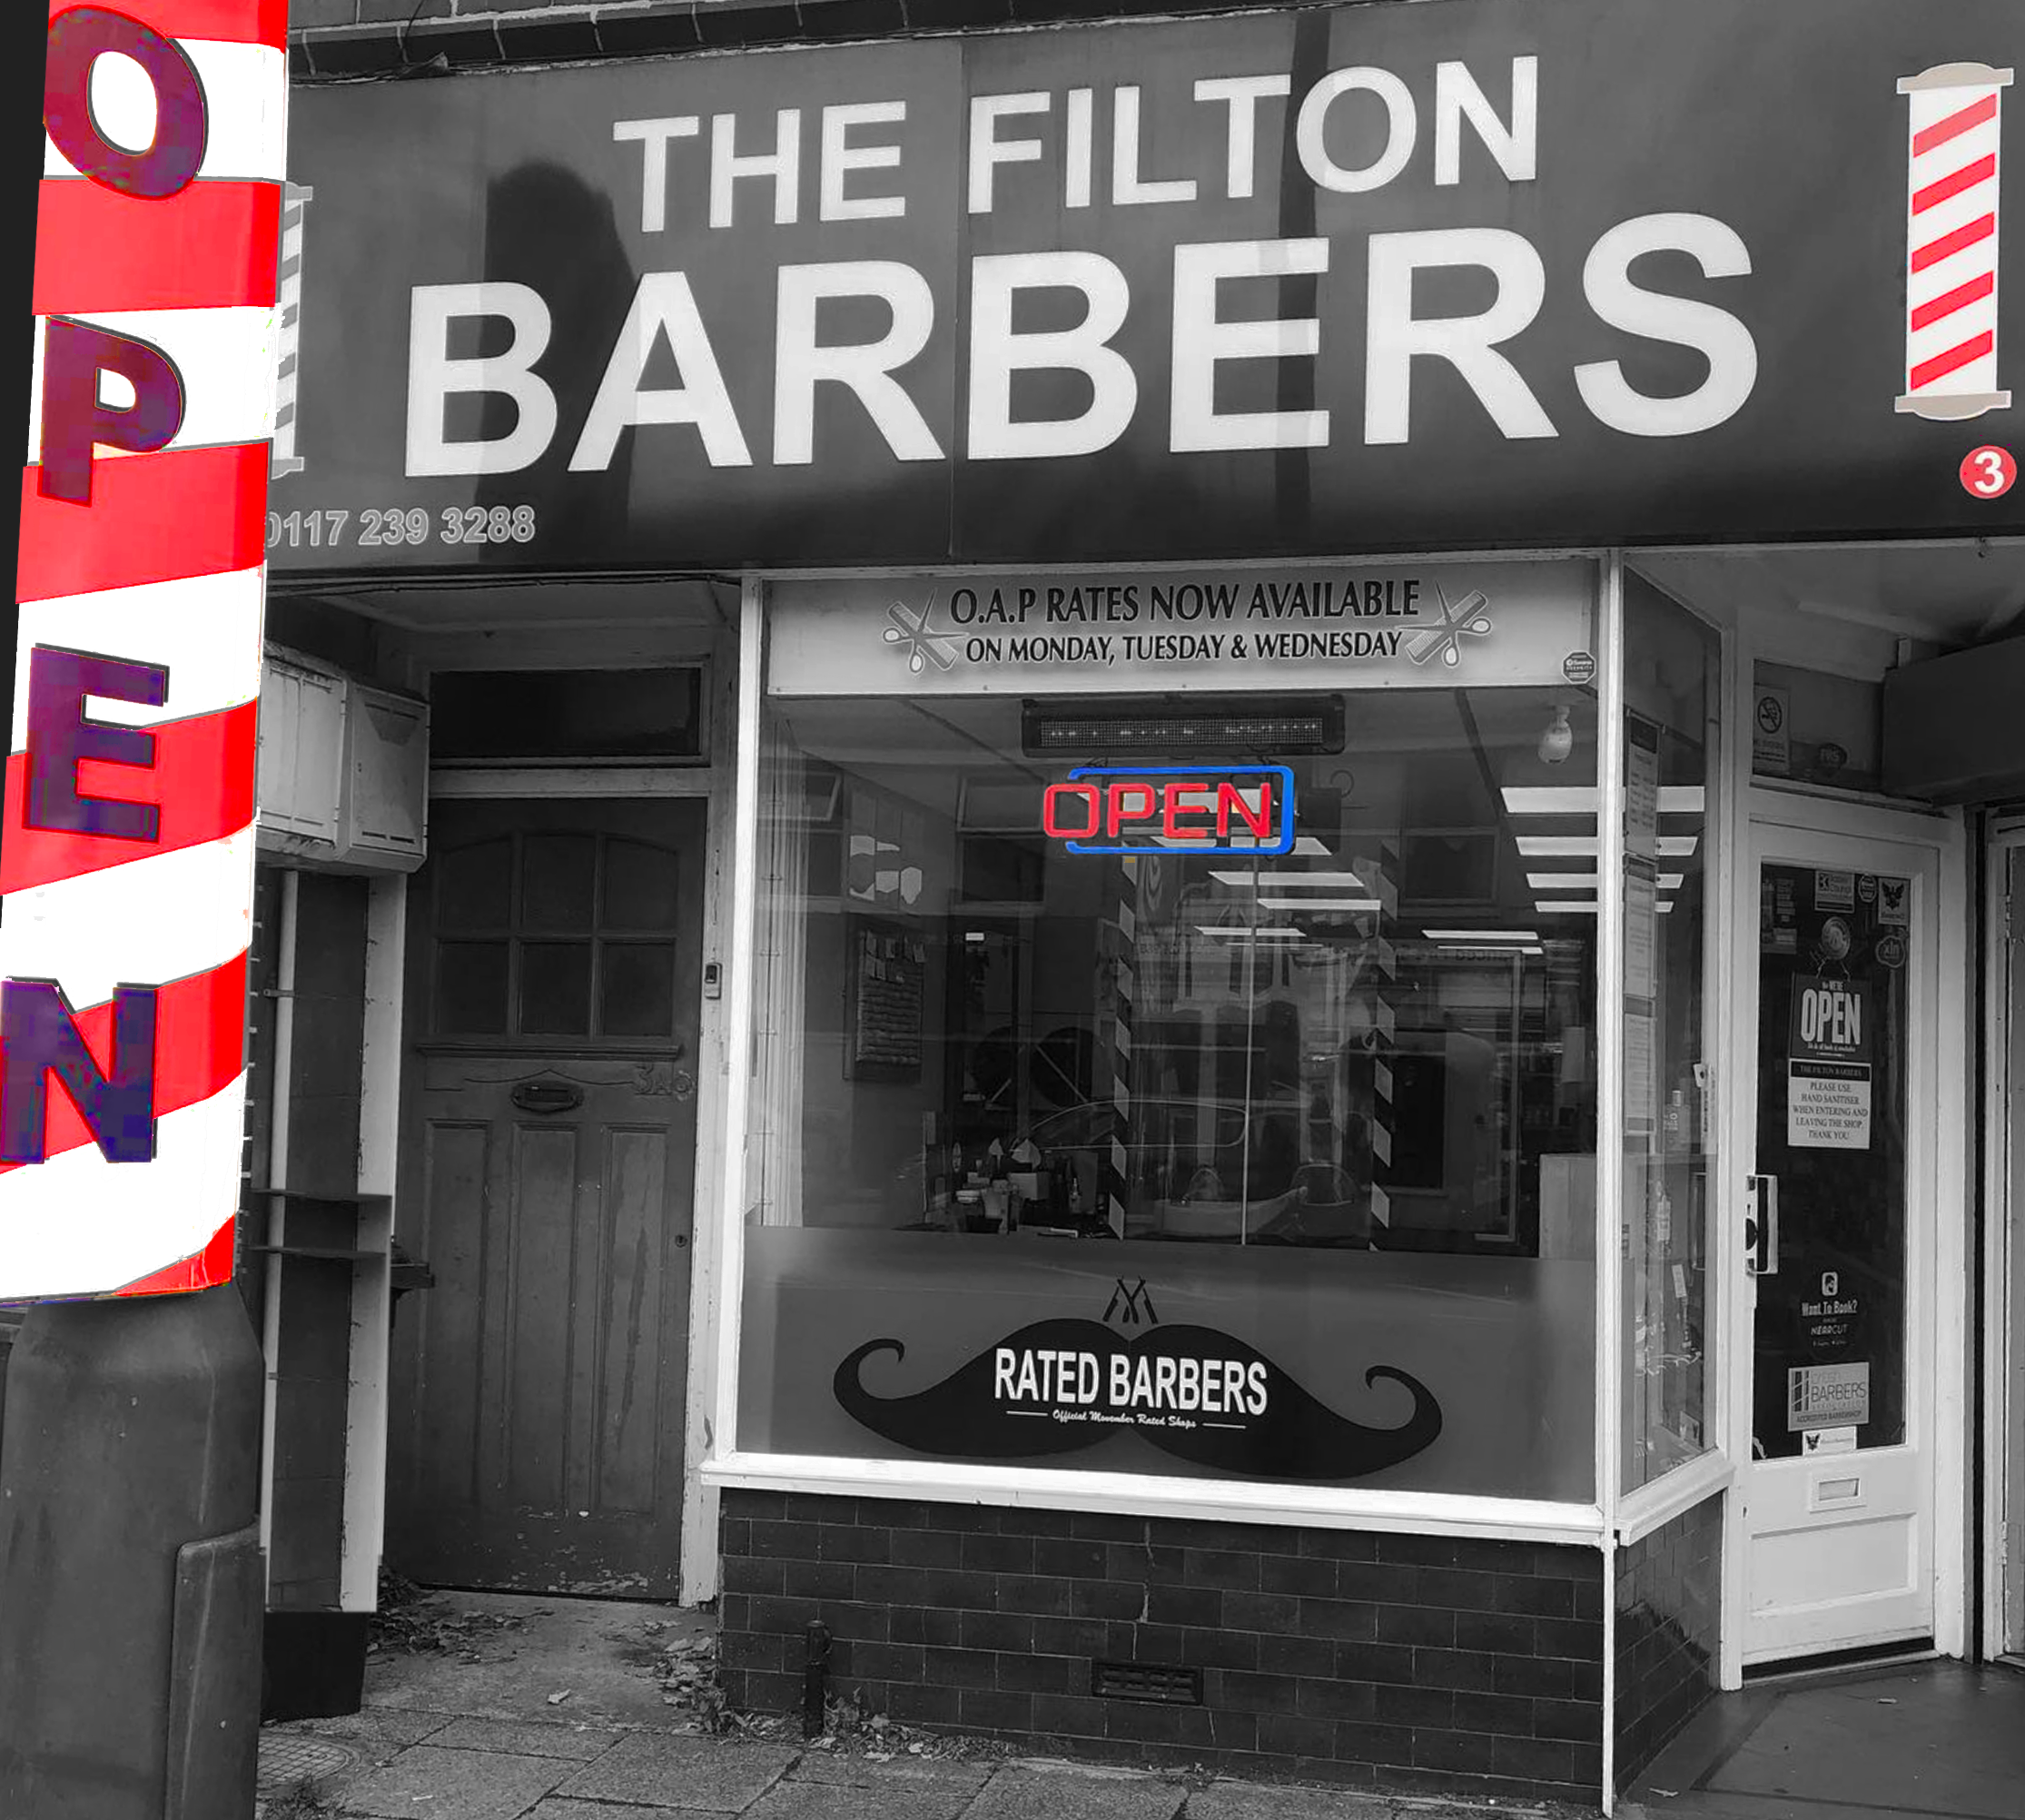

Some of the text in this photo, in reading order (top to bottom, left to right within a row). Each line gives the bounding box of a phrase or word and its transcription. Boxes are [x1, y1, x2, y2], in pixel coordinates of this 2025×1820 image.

[613, 54, 1538, 233] THE FILTON
[405, 212, 1758, 479] BARBERS
[1974, 451, 2005, 493] 3
[358, 507, 429, 547] 239
[440, 504, 536, 544] 3288
[1, 11, 207, 1165] OPEN
[950, 579, 1420, 623] O.A.P RATES NOW AVAILABLE
[966, 631, 1402, 666] ON MONDAY, TUESDAY & WEDNESDAY
[1043, 782, 1272, 839] OPEN
[1801, 988, 1862, 1045] OPEN
[1801, 1093, 1861, 1105] HAND SANITISER
[1810, 1081, 1852, 1093] PLEASE USE
[1793, 1104, 1869, 1118] WHEN ENTERING AND
[1795, 1116, 1828, 1128] LEAVING
[1829, 1118, 1842, 1129] THE
[1808, 1129, 1833, 1140] THANK
[1802, 1299, 1859, 1317] Want To Book?
[994, 1347, 1269, 1417] RATED BARBERS
[1811, 1381, 1868, 1403] BARBERS
[1052, 1409, 1197, 1429] Official Movember Rated Shops
